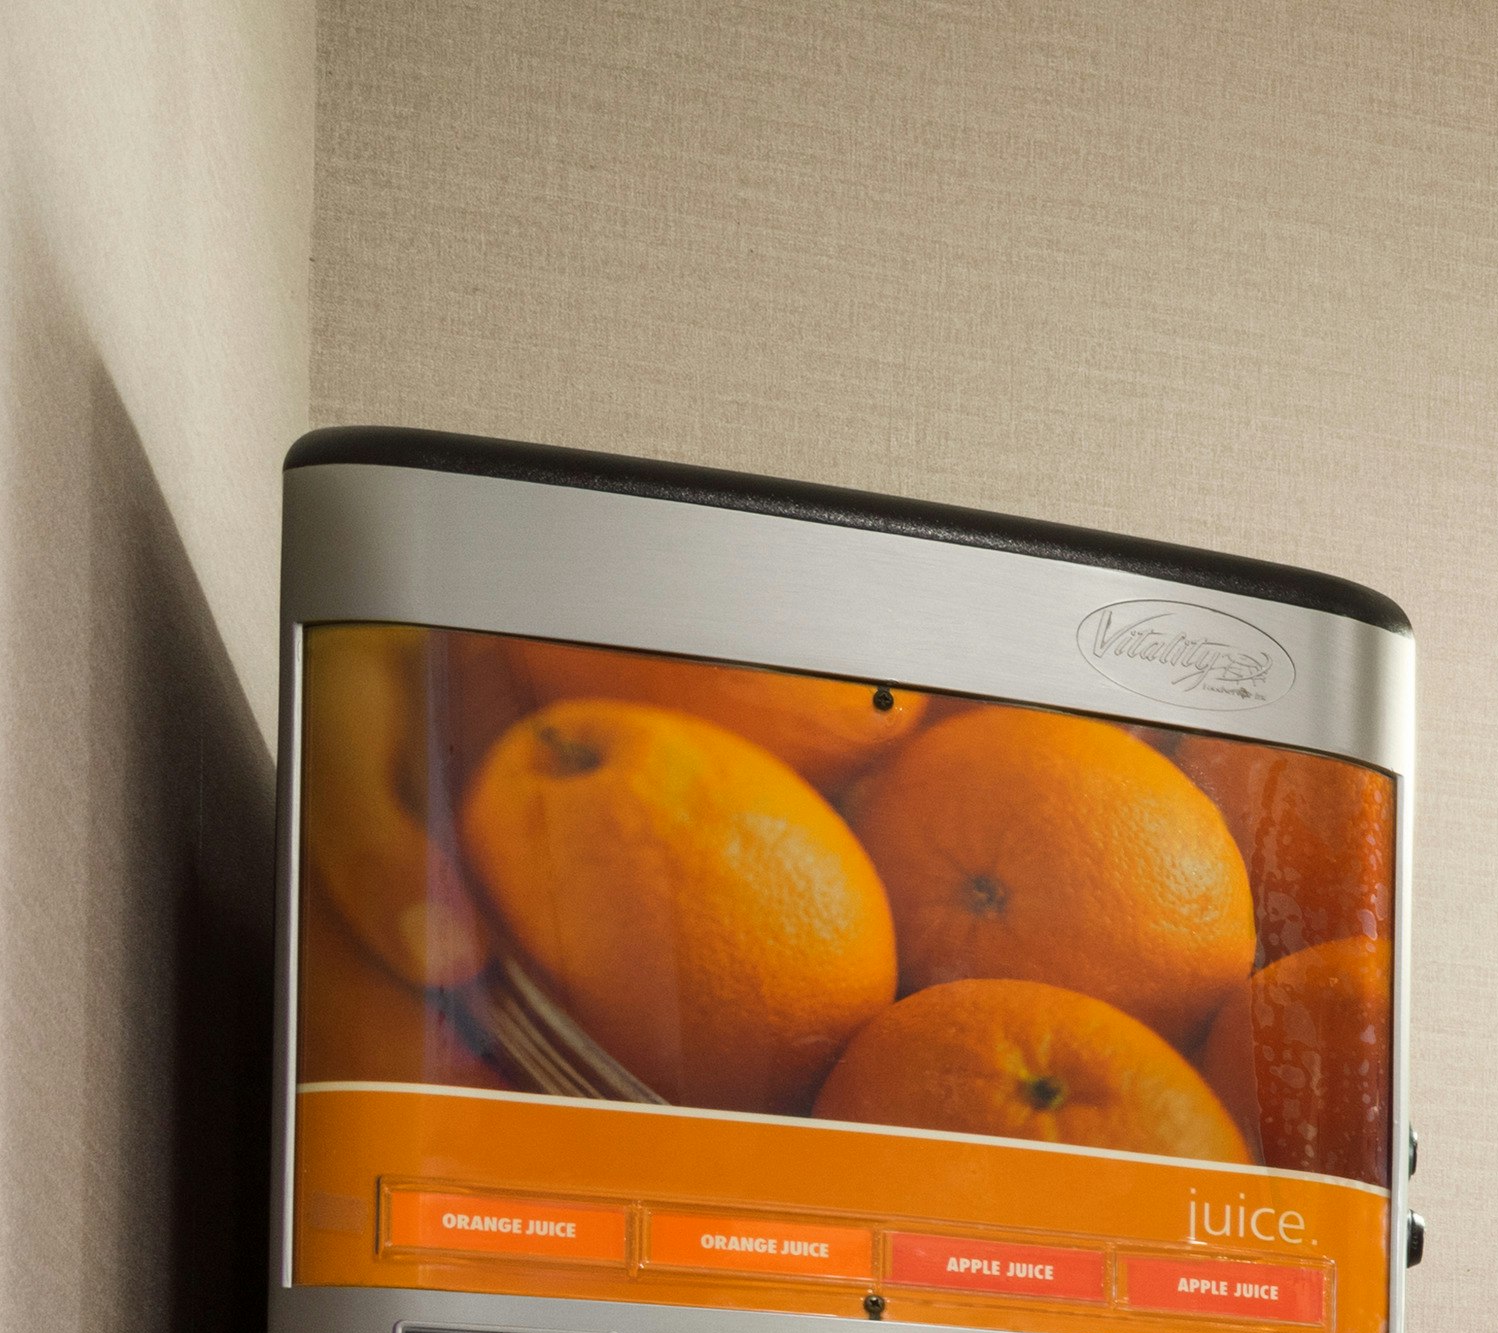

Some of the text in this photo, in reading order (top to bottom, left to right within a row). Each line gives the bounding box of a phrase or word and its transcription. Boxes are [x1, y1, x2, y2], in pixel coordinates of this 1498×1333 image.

[441, 1212, 577, 1239] ORANGE JUICE
[1187, 1187, 1318, 1250] juice.
[700, 1233, 829, 1259] ORANGE JUICE
[946, 1255, 1054, 1281] APPLE JUICE
[1178, 1277, 1279, 1301] APPLE JUICE
